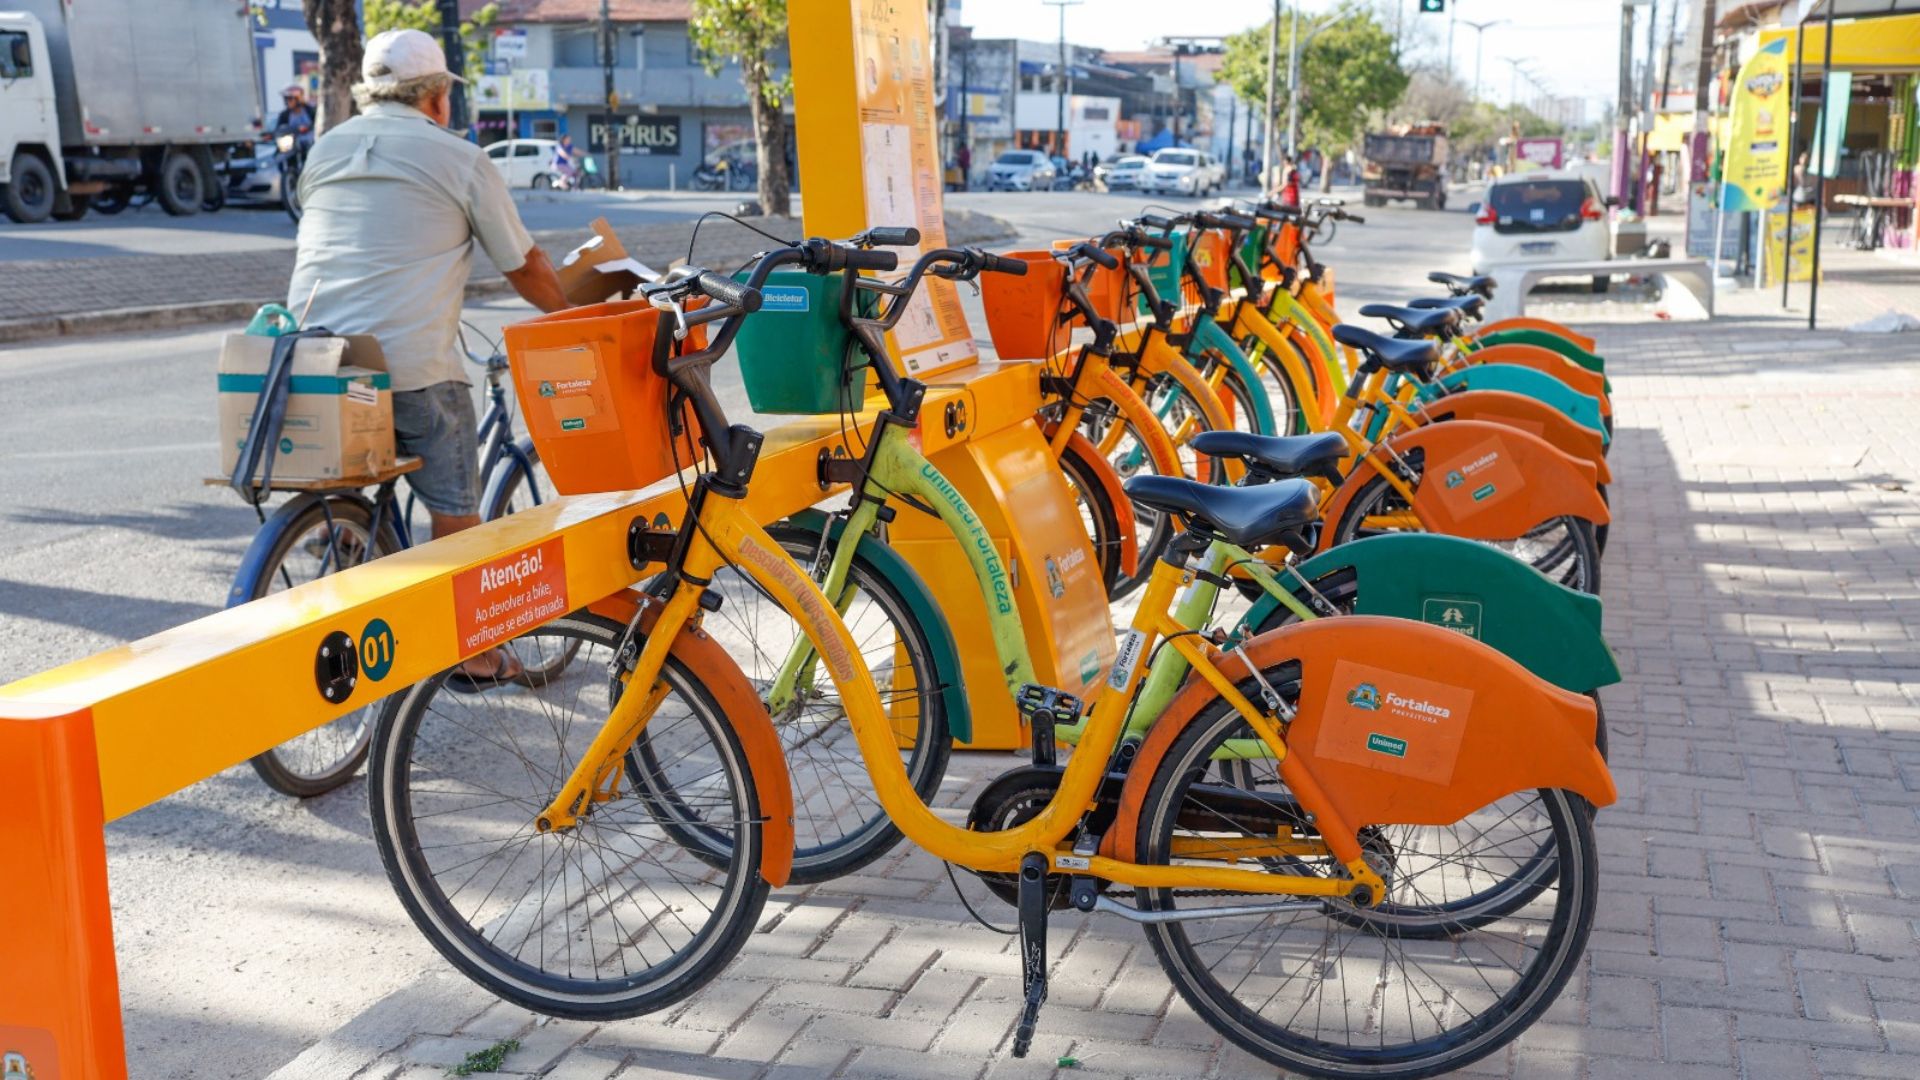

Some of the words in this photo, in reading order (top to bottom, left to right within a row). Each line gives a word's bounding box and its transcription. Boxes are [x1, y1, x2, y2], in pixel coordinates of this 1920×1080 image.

[556, 380, 592, 390] Fortaleza
[922, 463, 977, 525] Unimed
[971, 525, 1011, 614] Fortaleza
[480, 548, 543, 594] Atenção!
[475, 608, 488, 624] Ao
[489, 594, 526, 616] devolver
[526, 591, 532, 603] a
[532, 581, 552, 600] bike,
[467, 622, 505, 648] verifique
[505, 617, 516, 632] se
[516, 608, 534, 626] está
[535, 596, 564, 619] travada
[363, 631, 390, 668] 01
[1119, 633, 1137, 667] Fortaleza
[1385, 692, 1450, 718] Fortaleza
[1391, 708, 1438, 723] PREFEITURA
[1372, 736, 1404, 751] Unimed
